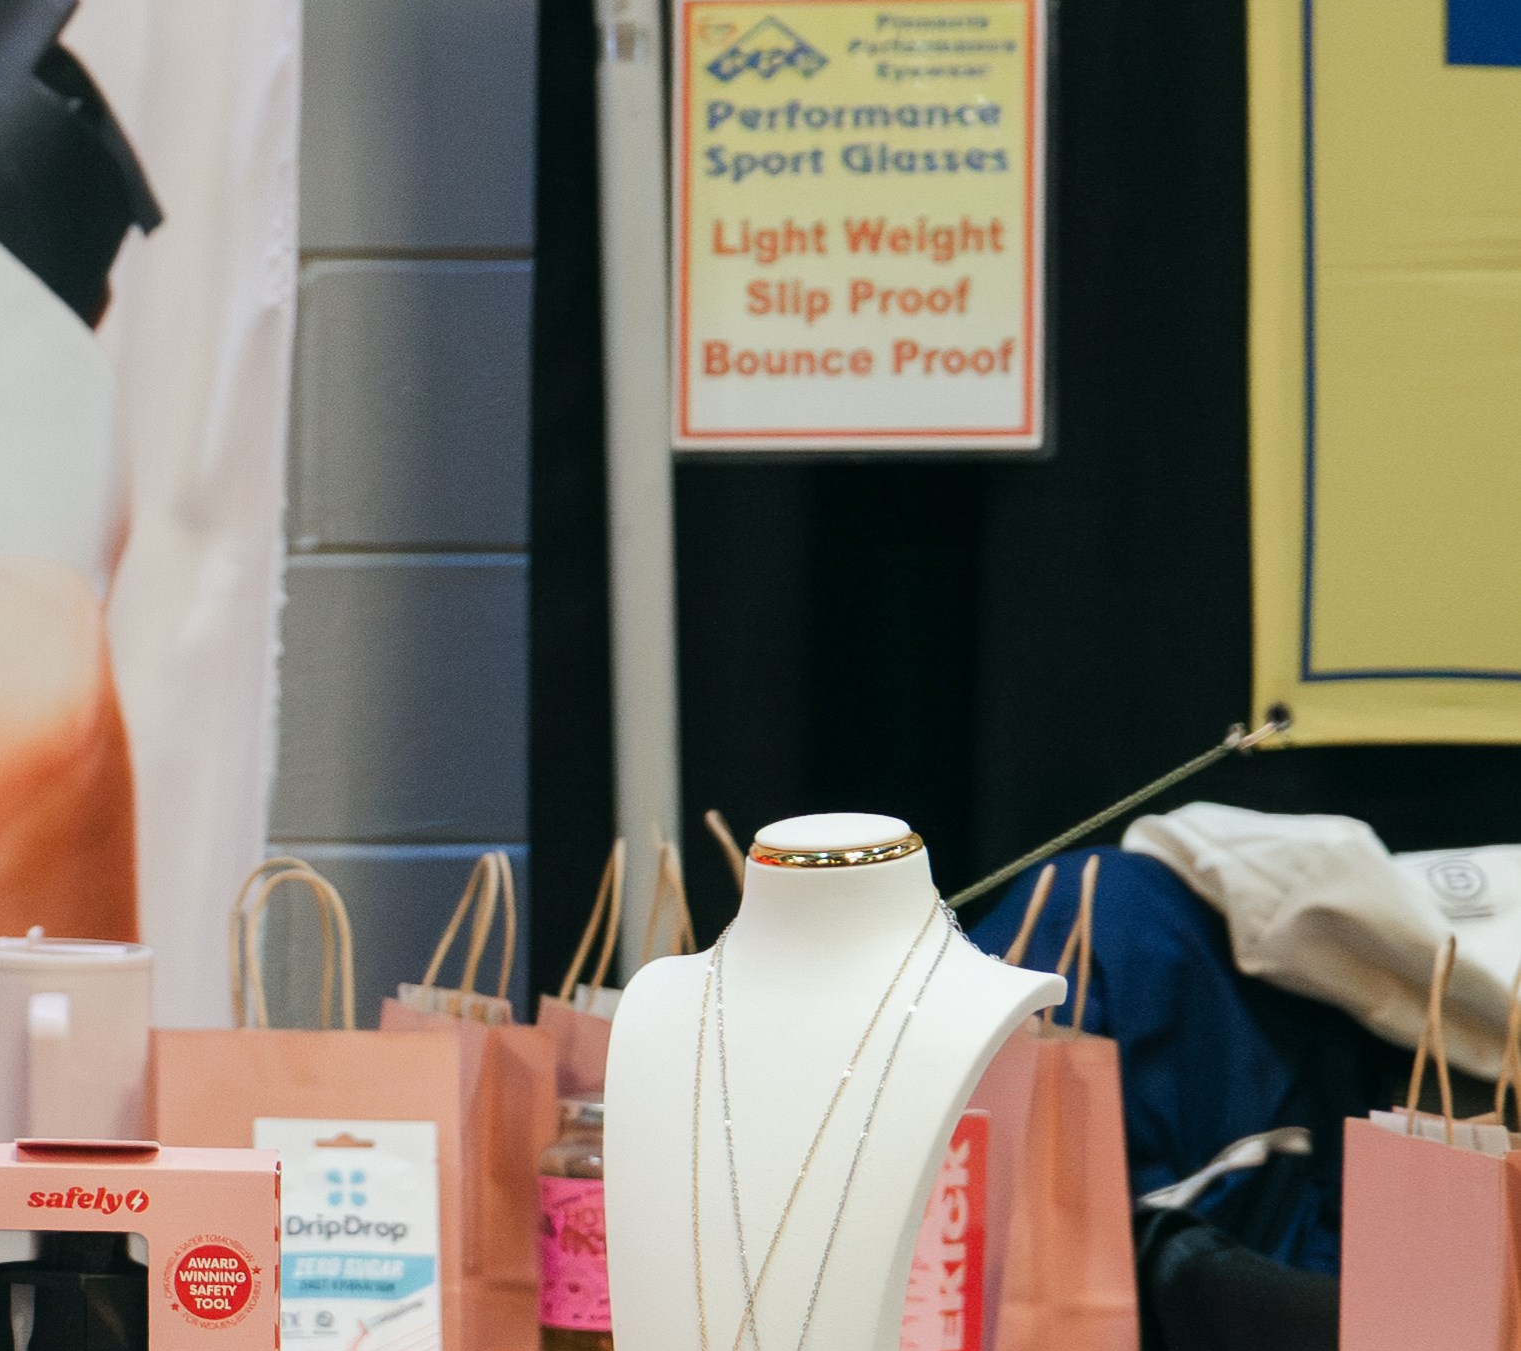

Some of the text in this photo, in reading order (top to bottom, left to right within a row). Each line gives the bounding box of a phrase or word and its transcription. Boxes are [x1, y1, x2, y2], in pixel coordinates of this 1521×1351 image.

[704, 99, 1002, 133] Performance
[702, 142, 1010, 183] Sport Glasses
[710, 215, 1005, 265] Light Weight
[745, 276, 972, 325] Slip Proof
[702, 335, 1017, 378] Bounce Proof
[26, 1185, 124, 1215] safely
[284, 1213, 408, 1242] DripDrop
[178, 1270, 247, 1283] WINNING
[187, 1257, 239, 1270] AWARD
[189, 1284, 238, 1297] SAFETY
[194, 1297, 232, 1310] TOOL
